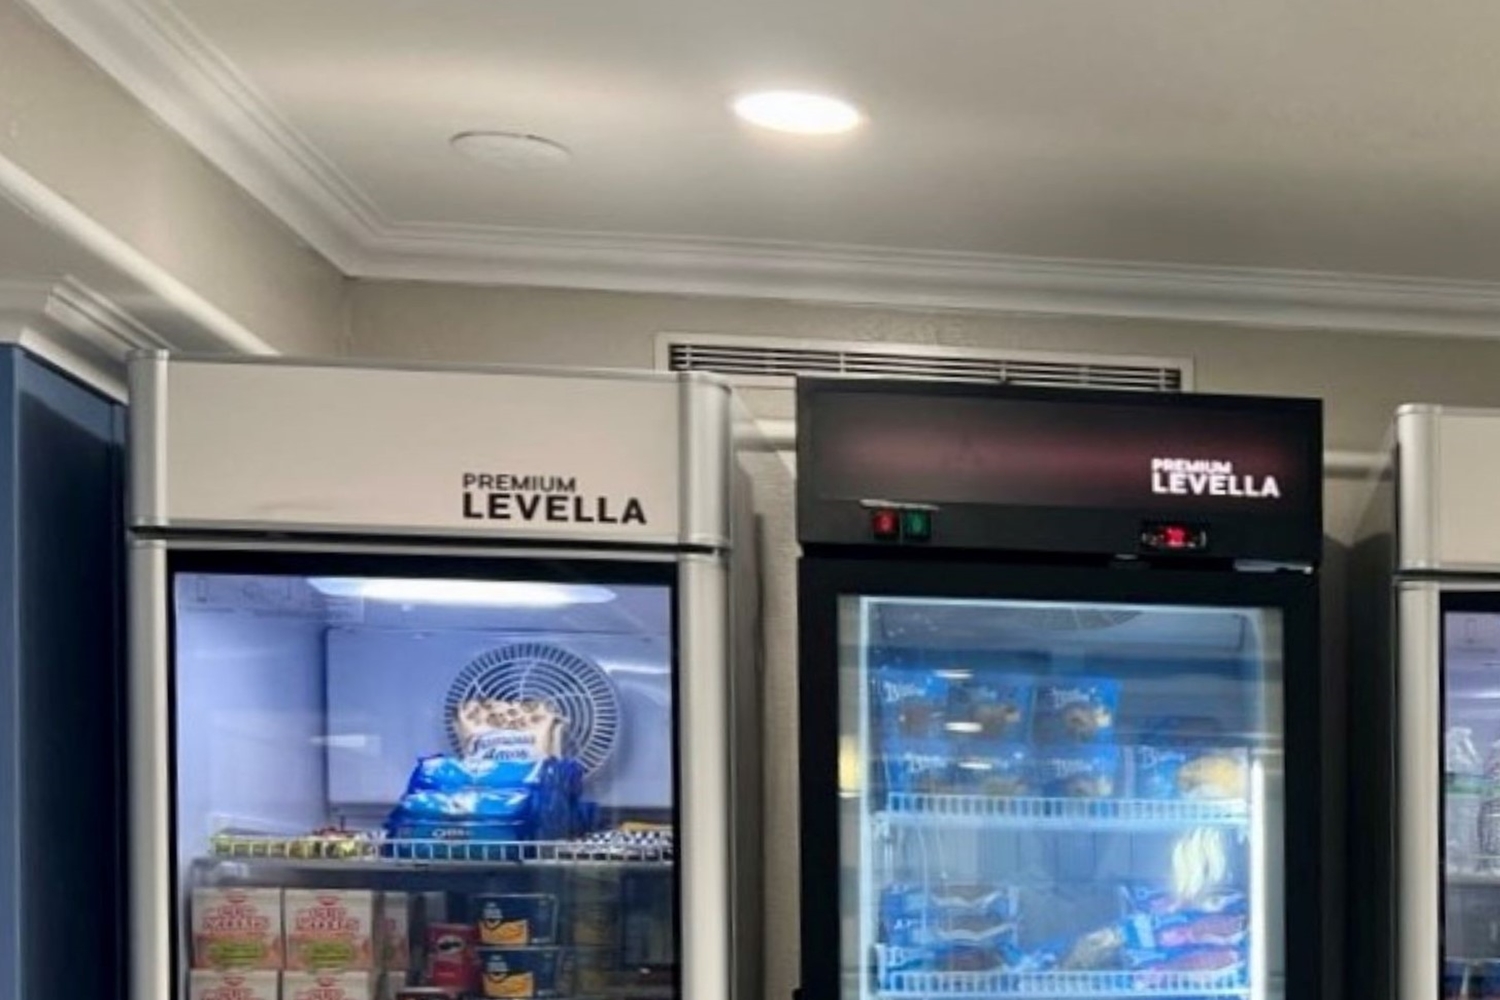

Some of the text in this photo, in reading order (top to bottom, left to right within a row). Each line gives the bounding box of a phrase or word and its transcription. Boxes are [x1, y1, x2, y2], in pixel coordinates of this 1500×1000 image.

[1151, 457, 1232, 475] PREMIUM
[462, 472, 577, 493] PREMIUM
[1151, 474, 1281, 498] LEVELLA
[462, 493, 648, 525] LEVELLA
